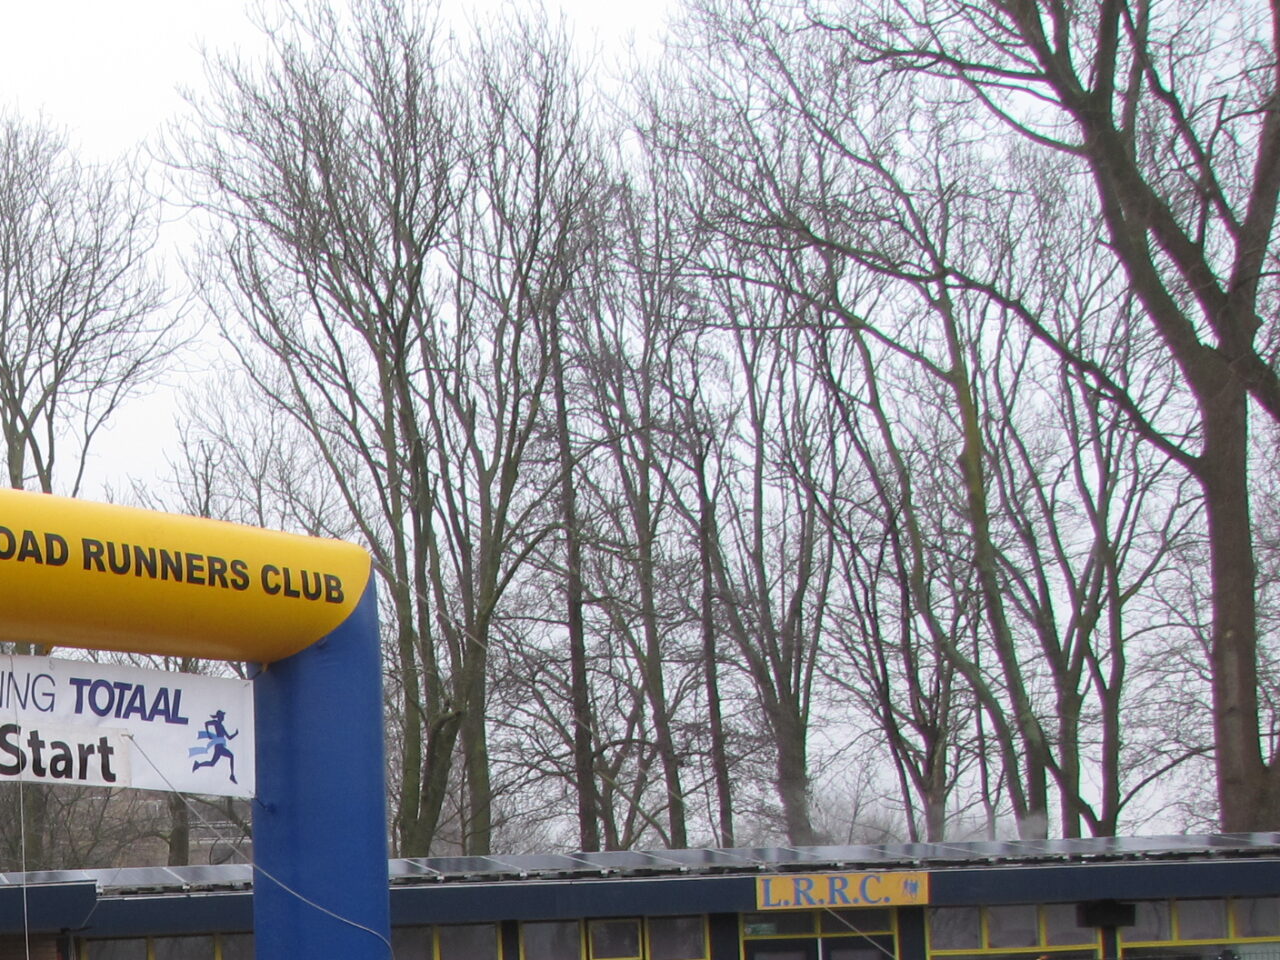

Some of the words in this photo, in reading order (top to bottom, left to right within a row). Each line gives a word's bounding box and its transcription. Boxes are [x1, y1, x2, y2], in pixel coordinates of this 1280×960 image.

[82, 538, 250, 591] RUNNERS
[261, 563, 345, 604] CLUB
[69, 677, 189, 725] TOTAAL
[761, 874, 892, 908] L.R.R.C.
